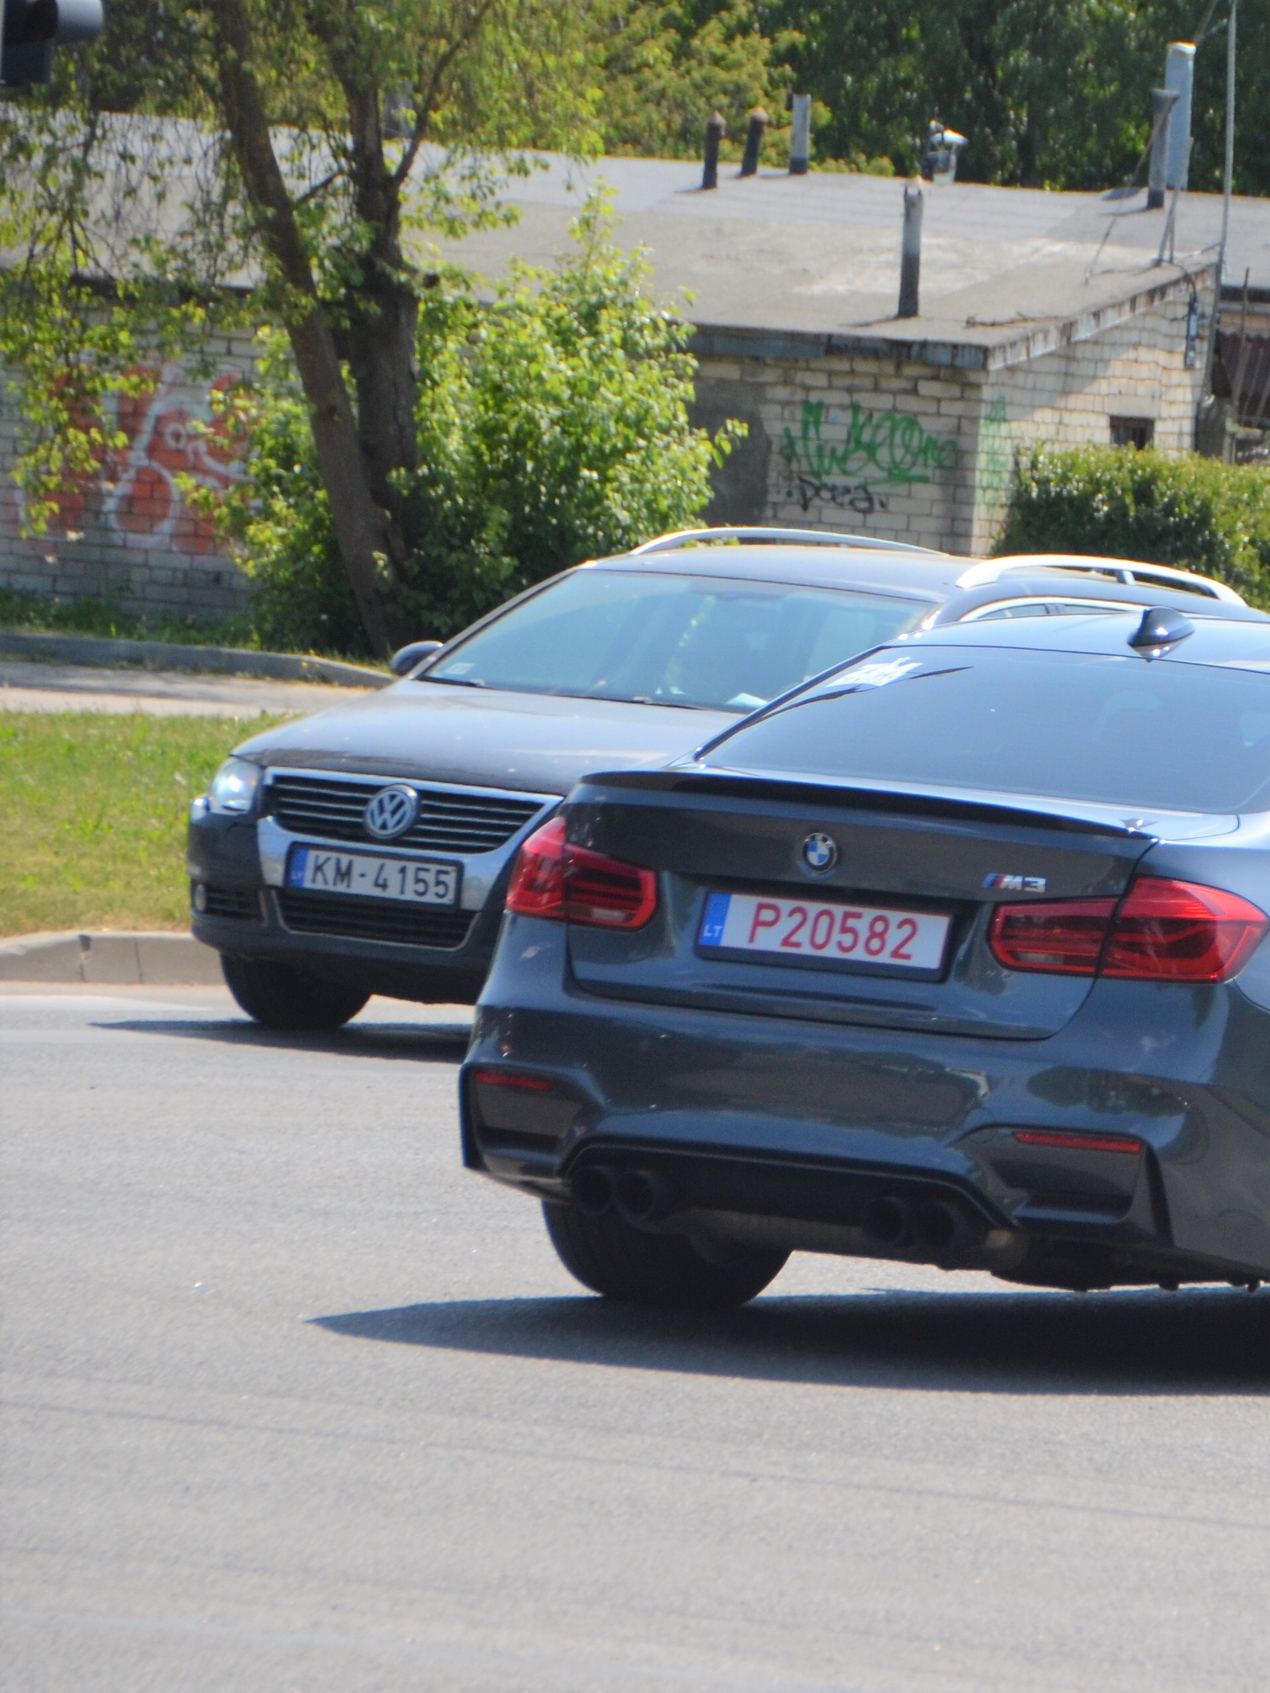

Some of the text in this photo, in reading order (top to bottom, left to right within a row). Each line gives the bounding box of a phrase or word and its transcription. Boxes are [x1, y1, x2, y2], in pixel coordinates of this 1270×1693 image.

[311, 854, 450, 899] KM-4155
[992, 873, 1048, 893] M3
[703, 925, 723, 938] LT
[747, 902, 919, 960] P20582
